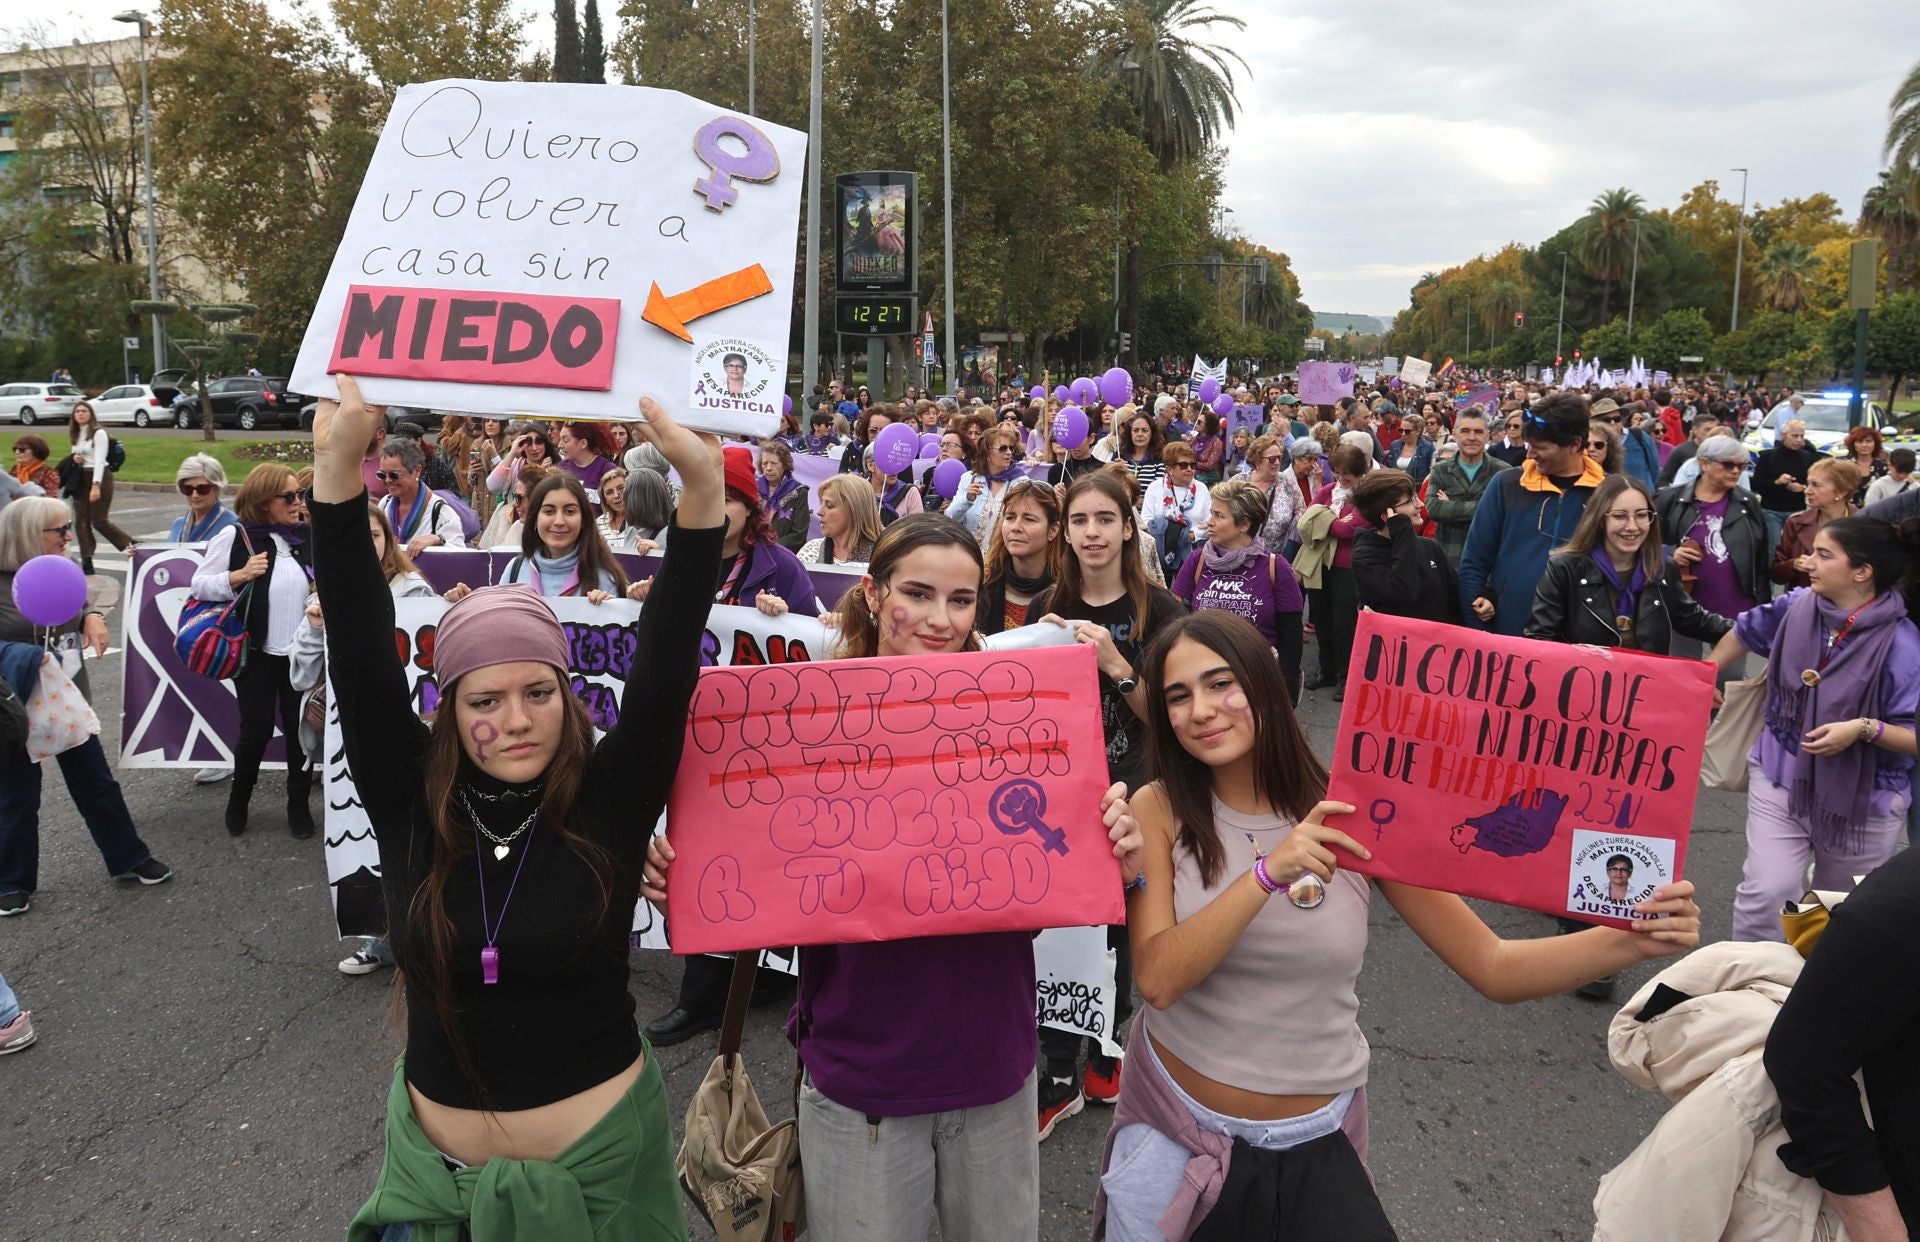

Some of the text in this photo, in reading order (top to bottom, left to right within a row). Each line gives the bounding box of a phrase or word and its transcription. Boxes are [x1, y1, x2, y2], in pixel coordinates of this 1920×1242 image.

[400, 86, 639, 164] Quiero
[381, 176, 690, 243] volver a
[361, 245, 611, 281] casa sin
[339, 292, 604, 368] MIEDO
[854, 306, 901, 322] 12 27
[707, 346, 764, 365] MALTRATADA
[703, 372, 768, 400] DESAPARECIDA
[699, 397, 775, 414] JUSTICIA
[1203, 589, 1252, 600] sin poseer
[1209, 579, 1245, 594] AMAR
[1200, 598, 1252, 610] ESTAR
[1416, 643, 1542, 710] GOLPES
[1557, 665, 1655, 732] QUE
[1353, 683, 1686, 792] DUELAN NI PALABRAS
[802, 743, 894, 794] TU
[1351, 731, 1420, 785] QUE
[1574, 781, 1644, 830] 25N
[1576, 839, 1605, 867] ANGELINES
[1605, 837, 1635, 846] ZURERA
[1589, 845, 1652, 868] MALTRATADA
[784, 855, 865, 915] TU
[1583, 875, 1656, 907] DESAPARECIDA
